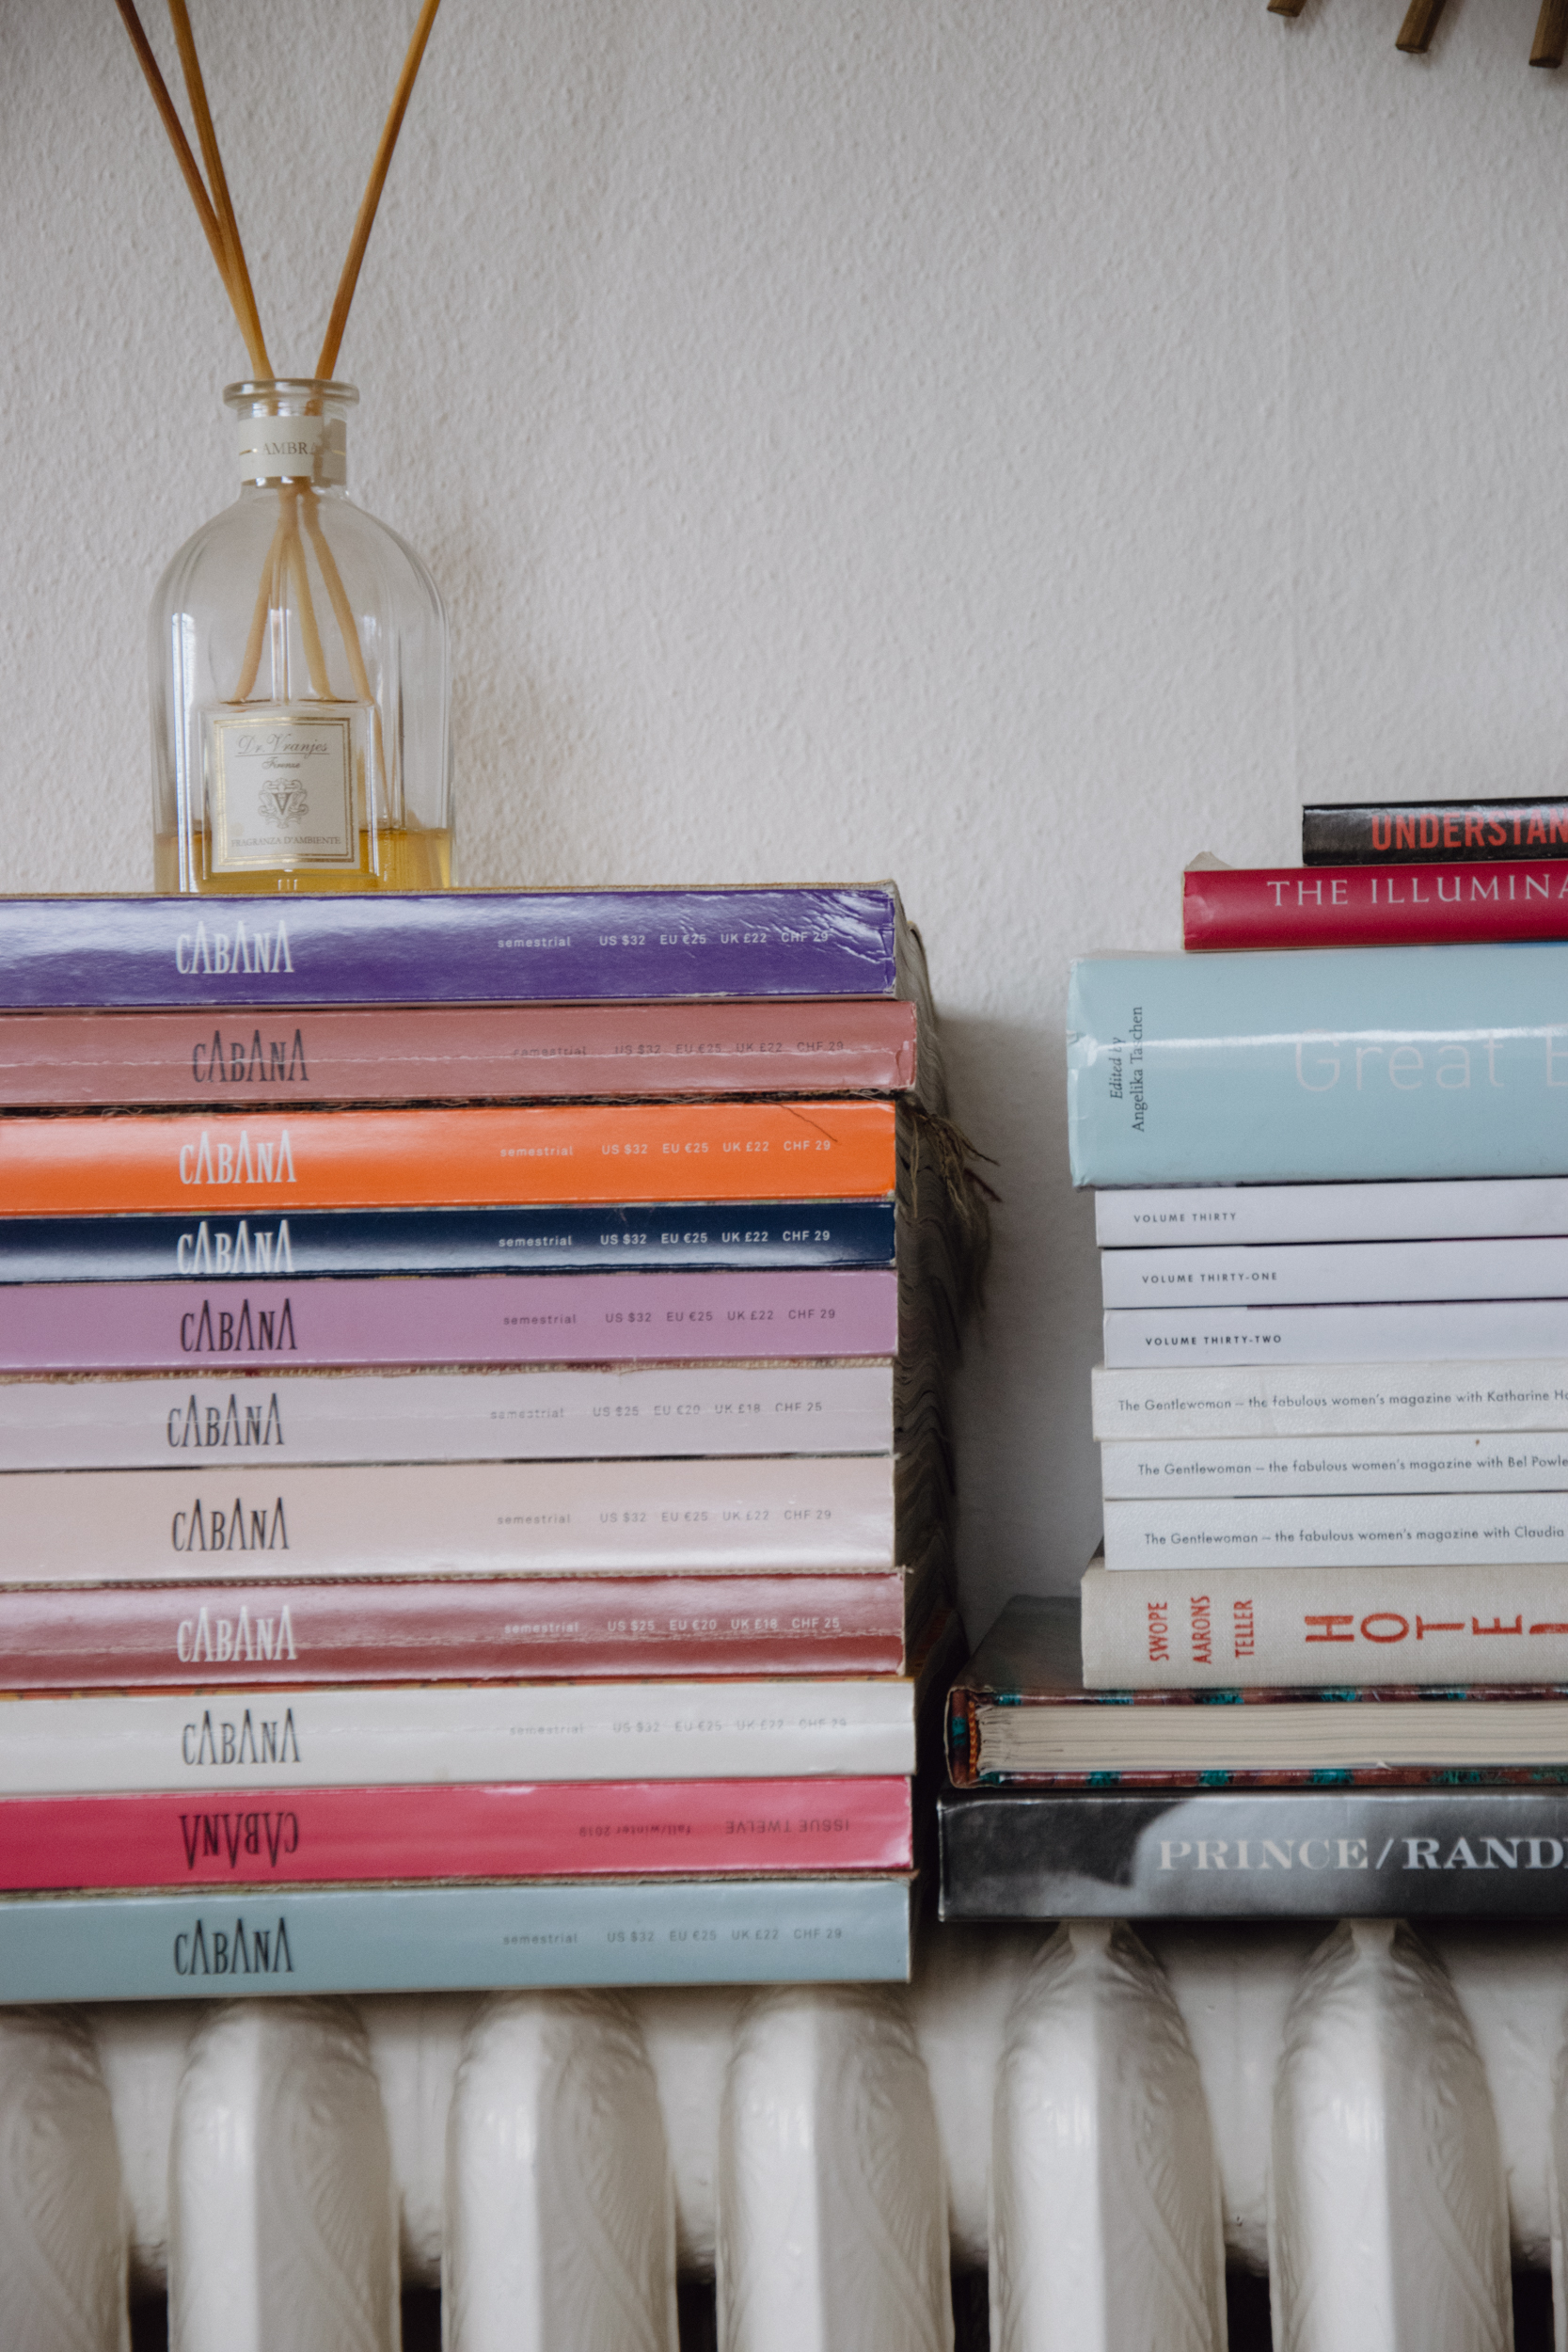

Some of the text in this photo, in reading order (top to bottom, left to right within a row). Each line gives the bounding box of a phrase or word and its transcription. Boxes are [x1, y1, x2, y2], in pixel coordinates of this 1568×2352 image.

[267, 734, 327, 759] Vranjes
[231, 837, 282, 847] FRAGRANZA
[1267, 880, 1349, 906] THE
[176, 920, 294, 974] CABANA
[498, 930, 828, 947] semestrial US $32 EU €25 UK £22 CHF 29
[192, 1028, 309, 1082] CABANA
[615, 1044, 633, 1056] US
[638, 1043, 660, 1057] $32
[675, 1043, 694, 1055] EU
[698, 1042, 721, 1054] €25
[736, 1042, 755, 1054] UK
[759, 1041, 782, 1054] £22
[797, 1041, 824, 1053] CHF
[829, 1041, 844, 1052] 29
[1294, 1027, 1505, 1091] Great
[1108, 1057, 1123, 1100] Edited
[1129, 1007, 1148, 1132] Angelika Taschen
[179, 1129, 296, 1184] CABANA
[500, 1140, 831, 1157] semestrial US $32 EU €25 UK £22 CHF 29
[1133, 1213, 1237, 1223] VOLUME THIRTY
[177, 1219, 294, 1275] CABANA
[499, 1231, 830, 1247] semestrial US $32 EU €25 UK £22 CHF 29
[1142, 1272, 1277, 1283] VOLUME THIRTY-ONE
[180, 1298, 297, 1352] CABANA
[504, 1309, 835, 1326] semestrial US $32 EU €25 UK £22 CHF 29
[1146, 1335, 1281, 1346] VOLUME THIRTY-TWO
[593, 1406, 611, 1418] US
[615, 1406, 639, 1419] $25
[654, 1406, 672, 1417] EU
[676, 1405, 700, 1416] €20
[714, 1404, 733, 1415] UK
[737, 1403, 760, 1415] £18
[775, 1402, 802, 1414] CHF
[807, 1402, 822, 1413] 25
[1118, 1400, 1140, 1411] The
[1145, 1398, 1231, 1411] Gentlewoman
[1248, 1396, 1267, 1408] the
[1273, 1395, 1327, 1408] fabulous
[1389, 1392, 1451, 1407] magazine
[1456, 1391, 1482, 1403] with
[1487, 1390, 1550, 1402] Katharine
[166, 1392, 285, 1447] CABANA
[1138, 1464, 1160, 1475] The
[1164, 1462, 1252, 1475] Gentlewoman
[1269, 1461, 1288, 1473] the
[1292, 1459, 1348, 1472] fabulous
[1410, 1457, 1472, 1472] magazine
[1477, 1456, 1503, 1469] with
[1508, 1455, 1528, 1468] Bel
[172, 1497, 290, 1551] CABANA
[498, 1510, 832, 1525] semestrial US $32 EU €25 UK £22 CHF 29
[1145, 1534, 1166, 1545] The
[1171, 1532, 1258, 1545] Gentlewoman
[1275, 1531, 1294, 1542] the
[1299, 1528, 1354, 1542] fabulous
[1417, 1528, 1479, 1543] magazine
[1483, 1527, 1510, 1539] with
[1514, 1526, 1564, 1539] Claudia
[177, 1605, 298, 1662] CABANA
[608, 1621, 626, 1632] US
[630, 1620, 654, 1633] $25
[669, 1620, 688, 1631] EU
[692, 1619, 716, 1630] €20
[731, 1619, 750, 1629] UK
[754, 1618, 777, 1629] £18
[793, 1617, 819, 1629] CHF
[825, 1617, 840, 1629] 25
[1148, 1601, 1169, 1662] SWOPE
[1190, 1596, 1212, 1664] AARONS
[1233, 1599, 1255, 1659] TELLER
[181, 1708, 301, 1765] CABANA
[617, 1823, 692, 1837] fall/winter
[724, 1820, 791, 1835] TWELVE
[799, 1819, 849, 1833] ISSUE
[179, 1812, 299, 1869] CABANA
[1157, 1836, 1568, 1870] PRINCE/RAND
[173, 1916, 294, 1976] CABANA
[503, 1929, 842, 1945] semestrial US $32 EU €25 UK £22 CHF 29
